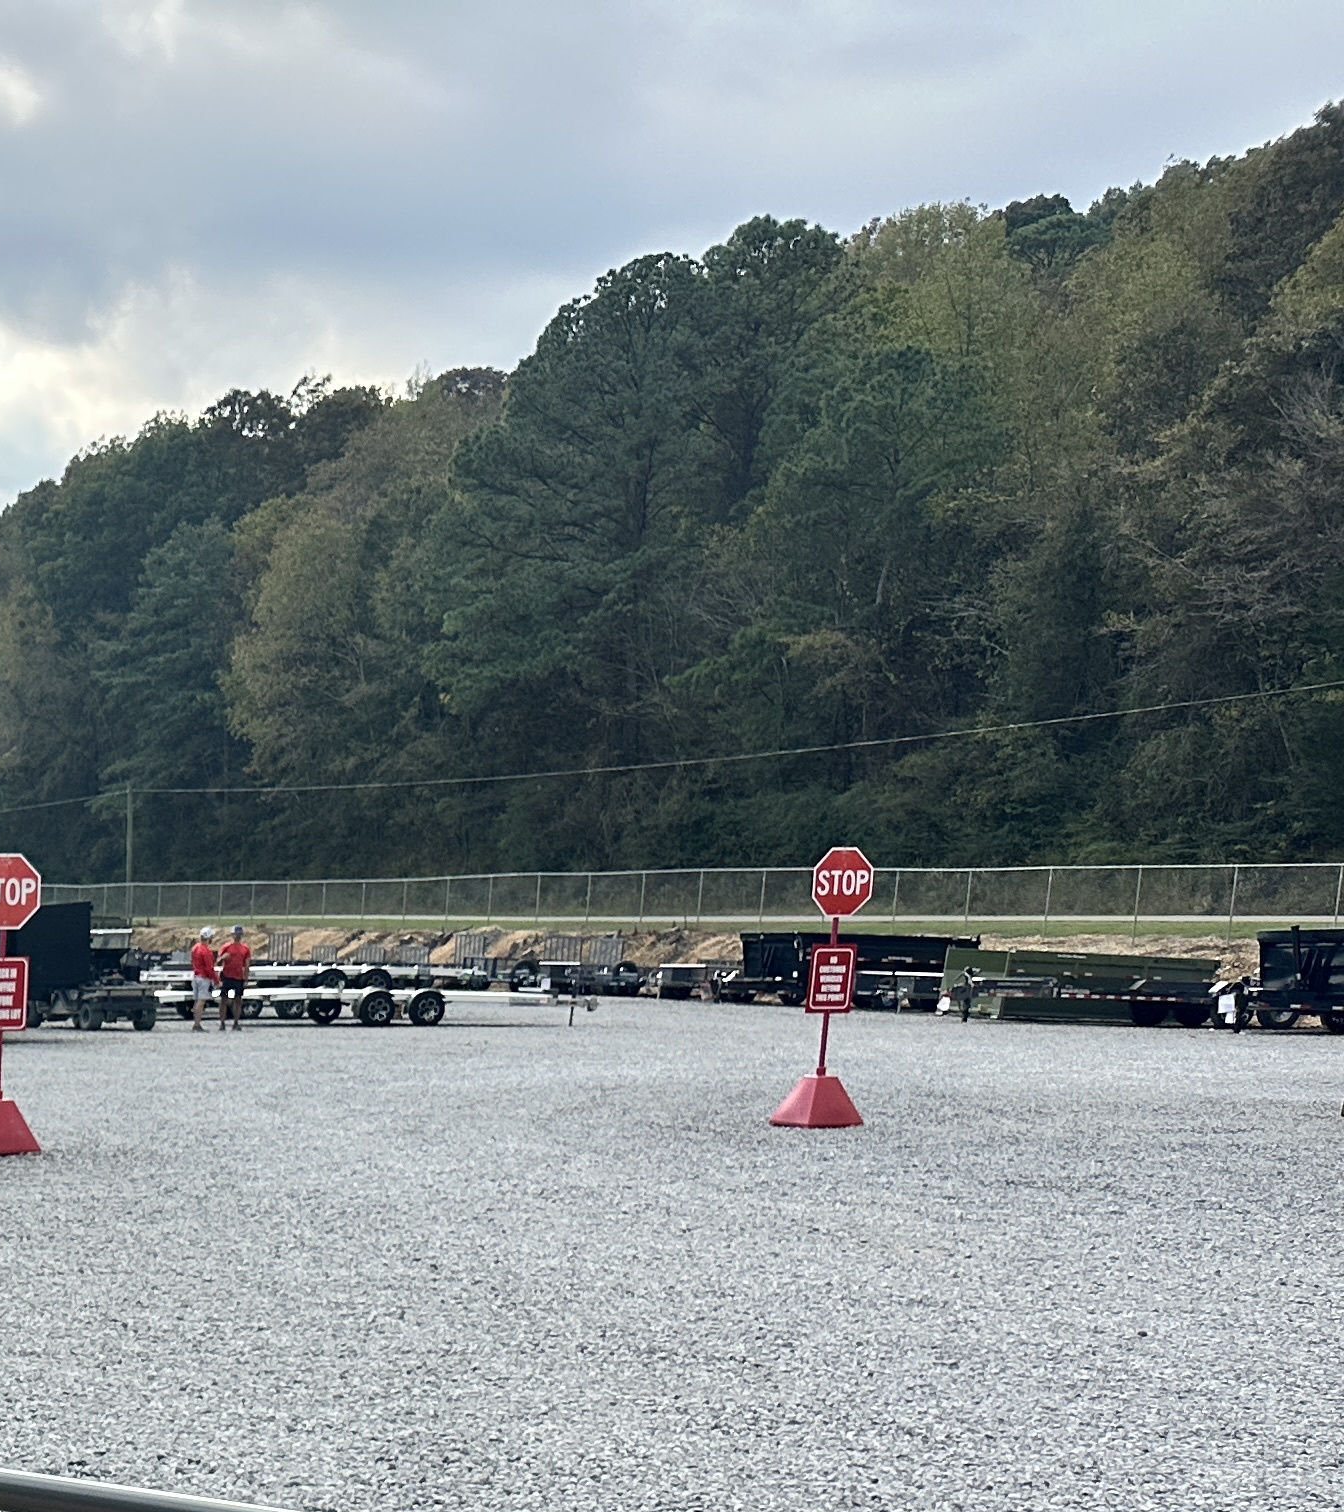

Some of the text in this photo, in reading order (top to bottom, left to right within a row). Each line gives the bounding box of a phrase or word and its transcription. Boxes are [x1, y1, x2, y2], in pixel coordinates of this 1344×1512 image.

[817, 870, 869, 895] STOP
[10, 967, 18, 979] IN
[10, 1008, 22, 1020] LOT
